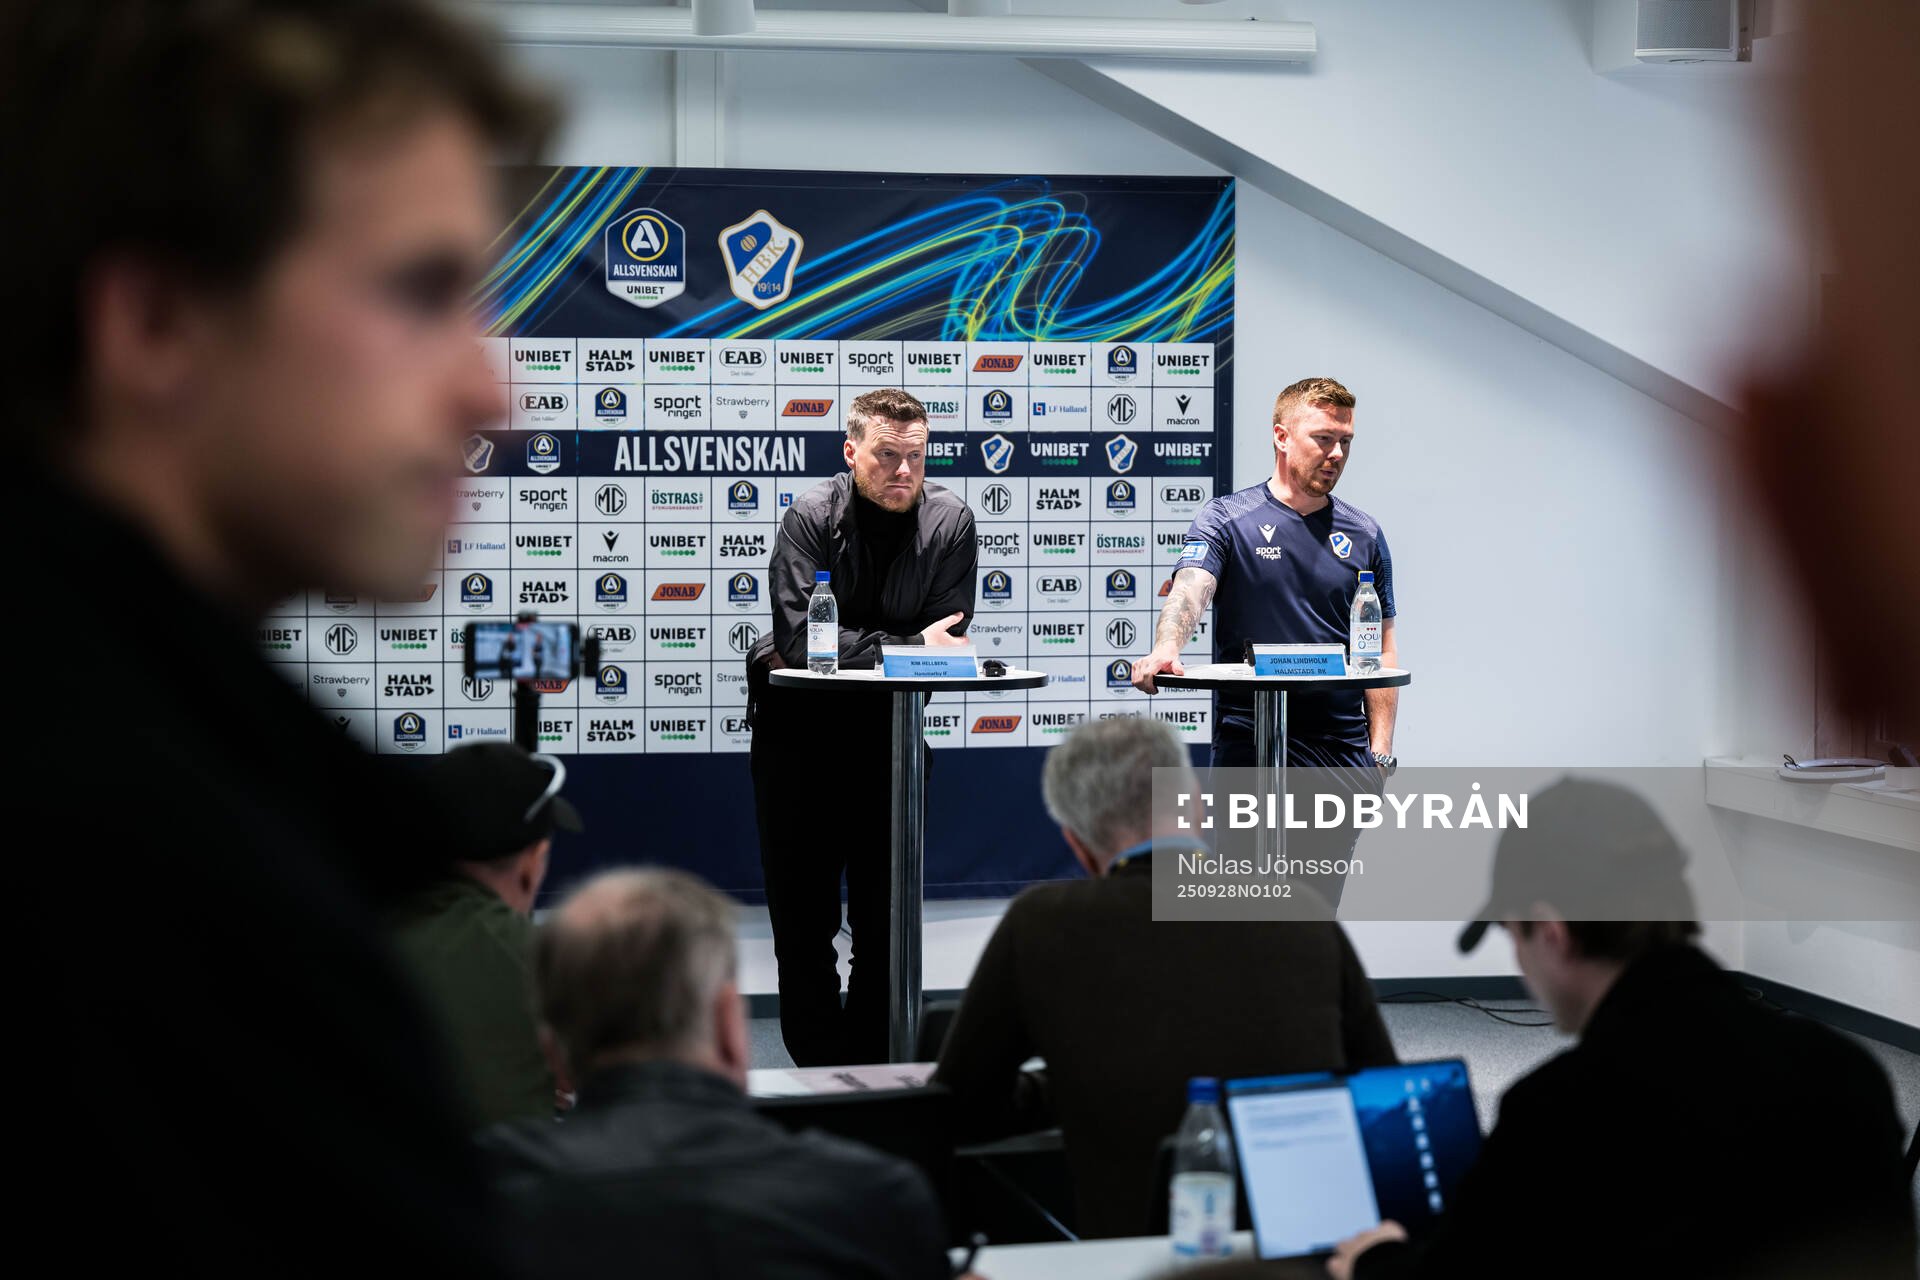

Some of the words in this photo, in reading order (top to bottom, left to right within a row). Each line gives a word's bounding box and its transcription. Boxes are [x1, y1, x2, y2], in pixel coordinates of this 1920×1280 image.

[614, 264, 677, 277] ALLSVENSKAN
[627, 286, 664, 294] UNIBET
[515, 350, 571, 362] UNIBET
[589, 350, 632, 360] HALM
[650, 351, 705, 362] UNIBET
[726, 351, 762, 364] EAB
[780, 352, 834, 364] UNIBET
[849, 352, 893, 367] sport
[908, 354, 961, 364] UNIBET
[1034, 354, 1086, 366] UNIBET
[1158, 355, 1209, 366] UNIBET
[586, 361, 625, 371] STAD
[981, 357, 1014, 368] JONAB
[862, 365, 893, 375] ringen
[526, 396, 563, 409] EAB
[654, 396, 701, 412] sport
[716, 397, 770, 407] Strawberry
[790, 402, 824, 413] JONAB
[922, 402, 954, 414] TRAS
[1111, 397, 1132, 422] MG
[668, 410, 701, 419] ringen
[614, 436, 805, 471] ALLSVENSKAN
[924, 444, 964, 457] IBET
[1031, 443, 1089, 456] UNIBET
[1154, 443, 1212, 456] UNIBET
[456, 489, 504, 500] trawberry
[520, 488, 567, 504] sport
[652, 490, 698, 504] ÖSTRAS
[1040, 489, 1079, 498] HALM
[1166, 489, 1200, 501] EAB
[599, 488, 623, 512] MG
[985, 487, 1008, 512] MG
[1036, 500, 1073, 510] STAD
[534, 503, 567, 512] ringen
[516, 536, 572, 547] UNIBET
[650, 536, 706, 547] UNIBET
[723, 535, 764, 545] HALM
[1034, 534, 1085, 546] UNIBET
[1097, 534, 1140, 548] ÖSTRAS
[720, 546, 759, 556] STAD
[988, 547, 1019, 556] ringen
[1256, 547, 1281, 556] sport
[523, 582, 566, 592] HALM
[1042, 579, 1077, 592] EAB
[520, 592, 561, 602] STAD
[660, 587, 696, 597] JONAB
[595, 628, 631, 640] EAB
[650, 628, 706, 640] UNIBET
[971, 624, 1022, 633] Strawberry
[1033, 624, 1084, 635] UNIBET
[1110, 620, 1133, 645] MG
[257, 630, 302, 641] NIBET
[329, 626, 354, 652] MG
[381, 629, 437, 641] UNIBET
[313, 675, 369, 686] Strawberry
[388, 675, 431, 685] HALM
[655, 672, 701, 688] sport
[385, 686, 426, 696] STAD
[668, 687, 702, 696] ringen
[924, 716, 960, 727] IBET
[1033, 714, 1084, 725] UNIBET
[1156, 712, 1206, 722] UNIBET
[539, 722, 572, 732] IBET
[590, 720, 633, 730] HALM
[650, 720, 706, 732] UNIBET
[979, 719, 1013, 730] JONAB
[587, 731, 626, 742] STAD
